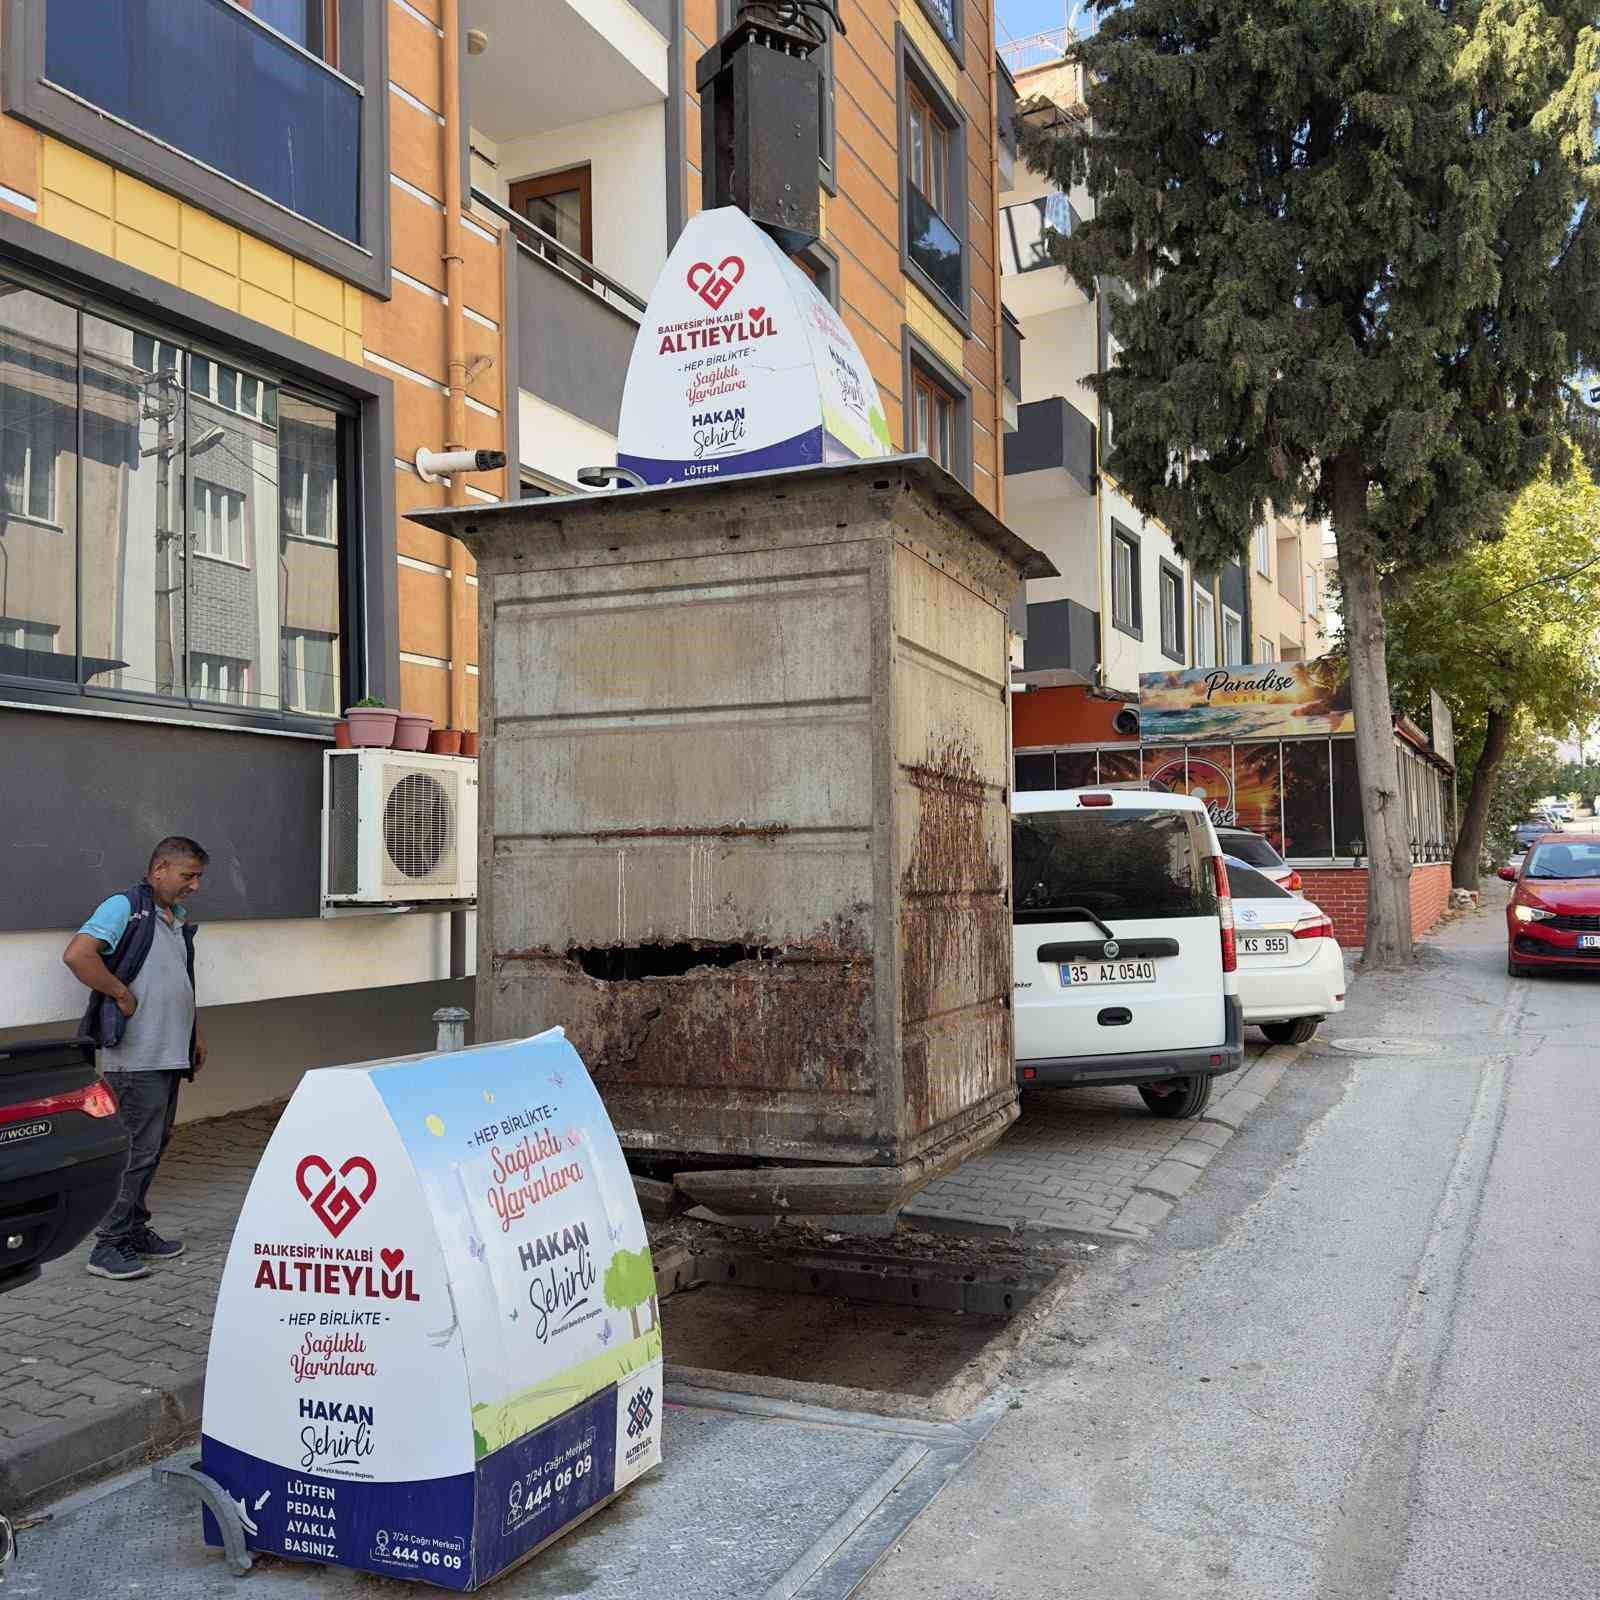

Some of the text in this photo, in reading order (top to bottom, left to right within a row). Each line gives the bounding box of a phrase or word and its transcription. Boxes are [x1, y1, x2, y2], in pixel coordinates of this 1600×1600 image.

[684, 348, 751, 373] HEP BİRLİKTE
[692, 407, 746, 427] HAKAN
[683, 463, 720, 477] LÜTFEN
[1204, 669, 1295, 700] Paradise
[1245, 938, 1285, 951] KS 955
[1071, 962, 1152, 982] 35 AZ 0540
[474, 1104, 553, 1147] HEP BİRLİKTE
[335, 1247, 373, 1262] KALBİ
[518, 1221, 590, 1272] HAKAN
[288, 1310, 381, 1326] HEP BİRLİKTE
[300, 1331, 367, 1360] Sağlıklı
[290, 1354, 377, 1384] Yarınlara
[299, 1398, 374, 1426] HAKAN
[287, 1480, 336, 1500] LÜTFEN
[525, 1454, 592, 1511] 444 06 09
[287, 1501, 337, 1520] PEDALA
[287, 1519, 337, 1539] AYAKLA
[392, 1531, 409, 1542] 7/24
[284, 1538, 339, 1559] BASINIZ.
[392, 1546, 419, 1562] 444
[421, 1551, 440, 1566] 06
[443, 1554, 462, 1569] 09
